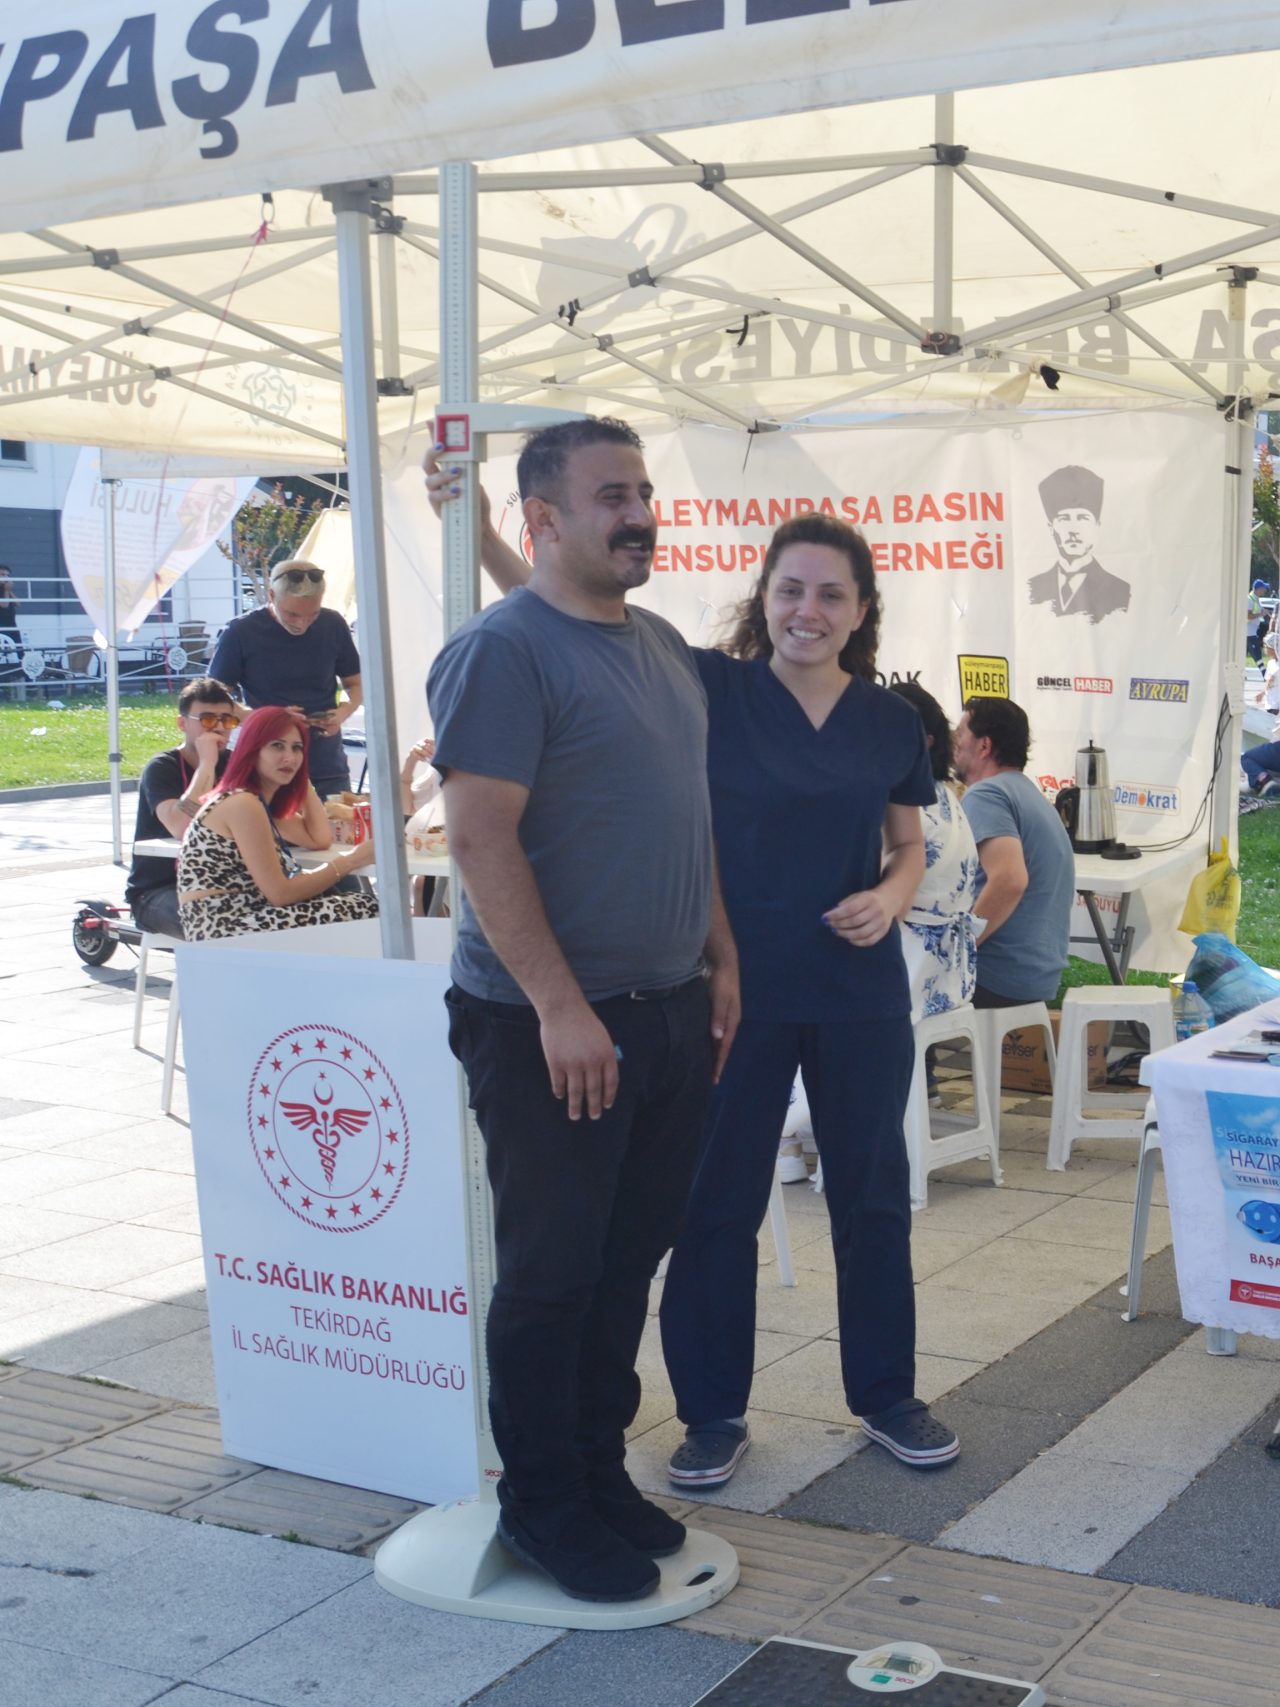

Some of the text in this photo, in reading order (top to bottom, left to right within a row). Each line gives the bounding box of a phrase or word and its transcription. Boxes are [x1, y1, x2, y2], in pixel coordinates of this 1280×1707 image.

[0, 0, 376, 159] PAŞA
[893, 491, 1004, 525] BASIN
[871, 532, 1004, 571] ERNEĞİ
[964, 671, 1006, 693] HABER
[1037, 675, 1111, 692] GÜNCEL HABER
[1131, 682, 1187, 702] AVRUPA
[1236, 1175, 1260, 1184] YENİ
[1263, 1177, 1280, 1186] BİR
[215, 1253, 468, 1315] T.C. SAĞLIK BAKANLIĞ
[290, 1305, 392, 1343] TEKİRDAĞ
[232, 1324, 466, 1391] İL SAĞLIK MÜDÜRLÜĞÜ
